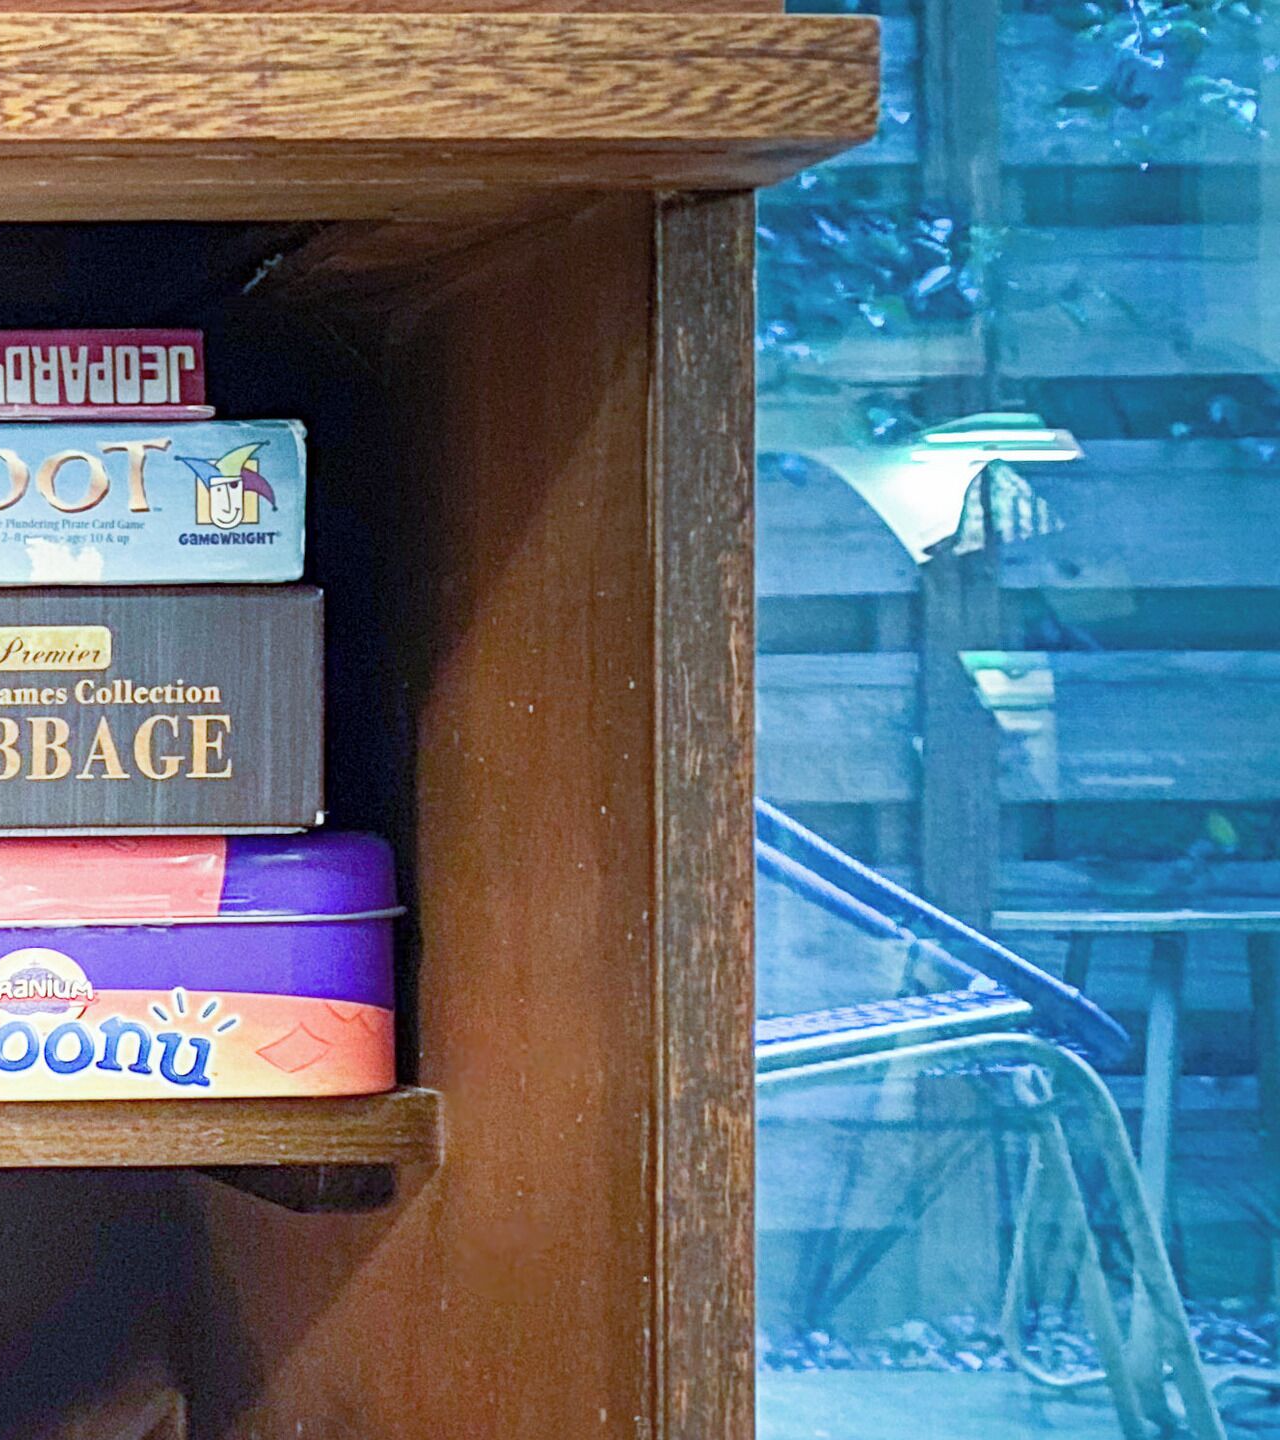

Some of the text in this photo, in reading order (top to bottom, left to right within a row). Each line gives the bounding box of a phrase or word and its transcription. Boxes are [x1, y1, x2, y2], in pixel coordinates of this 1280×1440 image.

[6, 518, 60, 531] Plundering
[61, 518, 90, 530] Pirate
[92, 519, 115, 529] Card
[117, 519, 145, 530] Game
[75, 679, 222, 705] Collection
